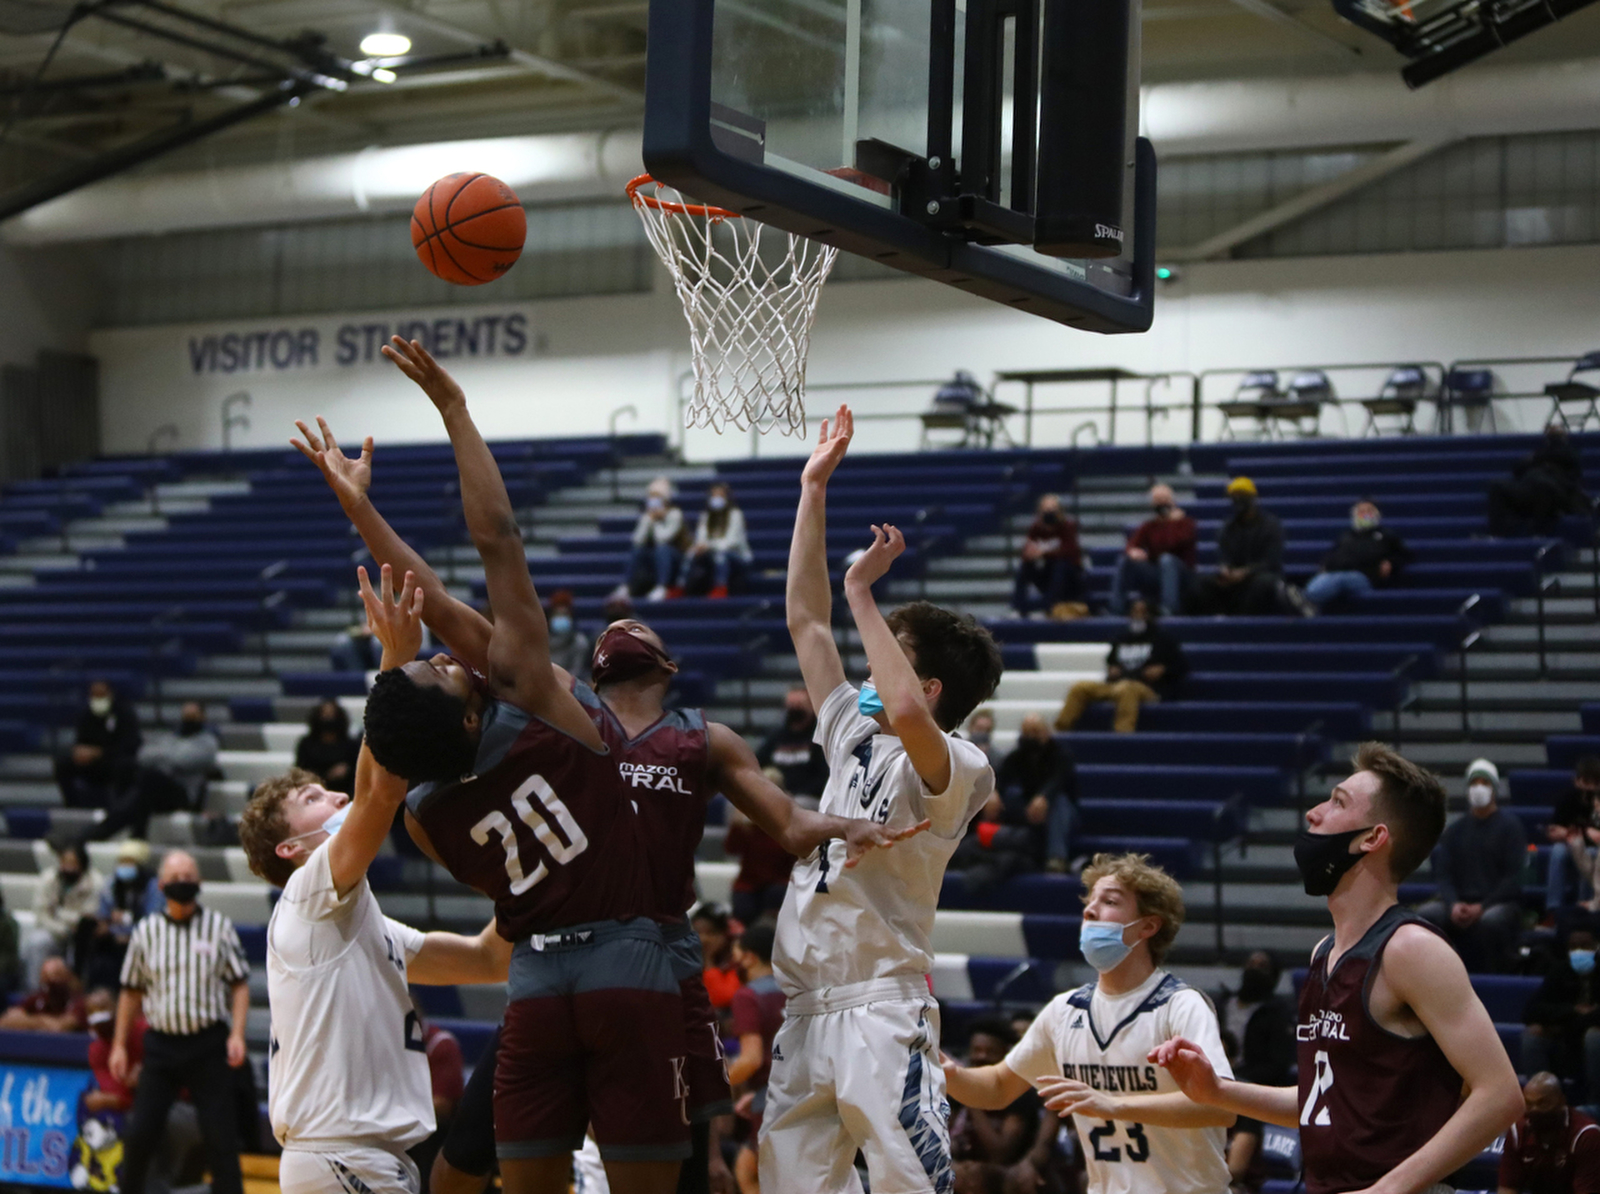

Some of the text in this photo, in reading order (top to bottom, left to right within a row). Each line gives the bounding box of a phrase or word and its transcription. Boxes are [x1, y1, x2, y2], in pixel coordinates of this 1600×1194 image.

[188, 312, 527, 374] VISITOR STUDENTS
[470, 774, 588, 896] 20
[1088, 1120, 1149, 1163] 23
